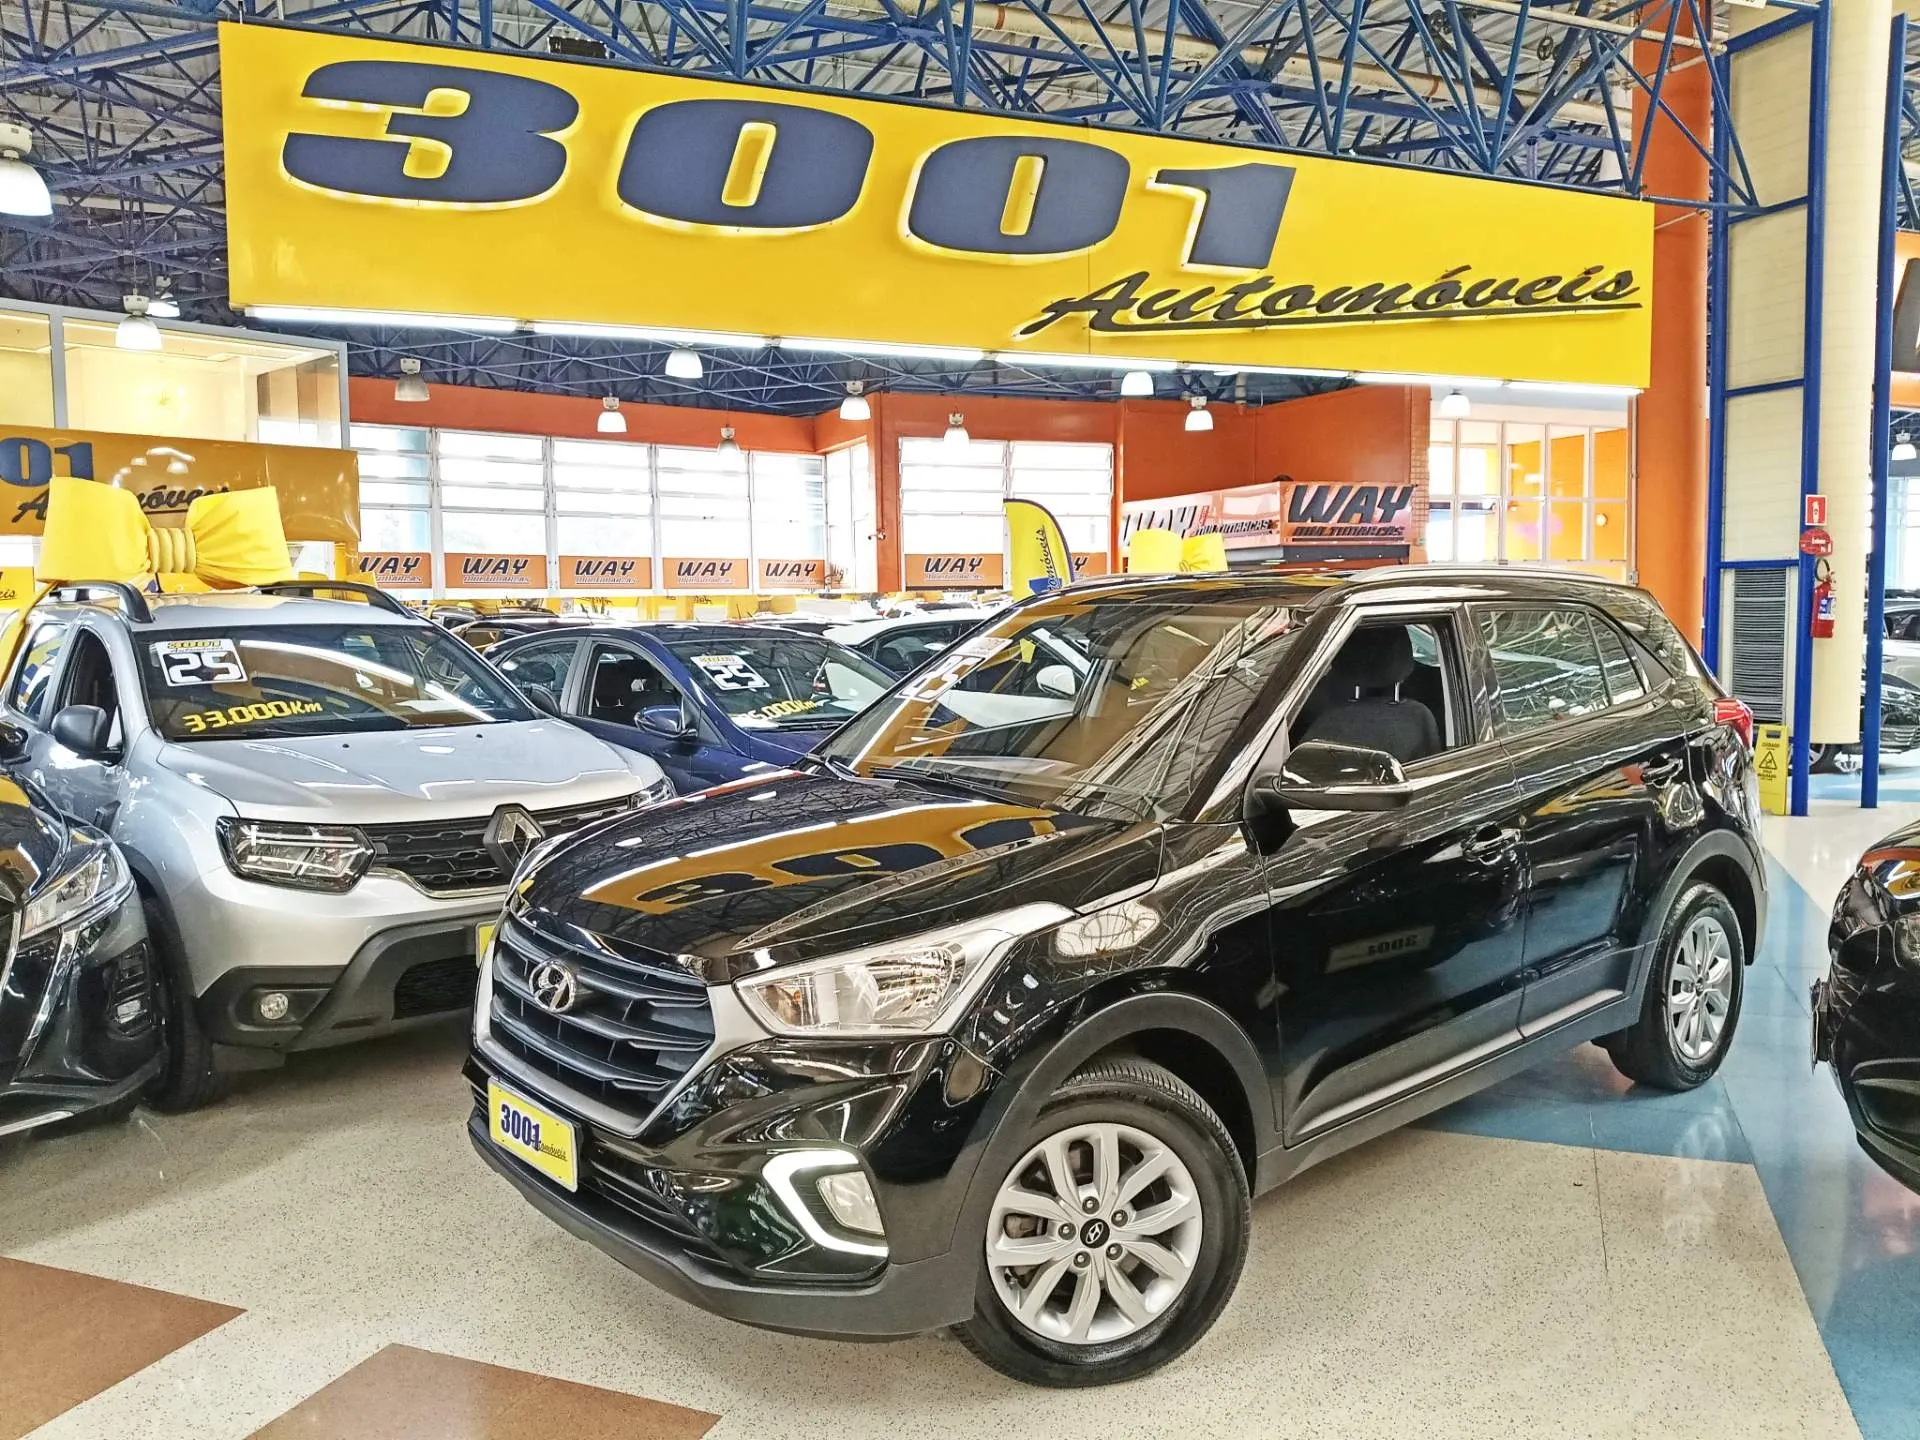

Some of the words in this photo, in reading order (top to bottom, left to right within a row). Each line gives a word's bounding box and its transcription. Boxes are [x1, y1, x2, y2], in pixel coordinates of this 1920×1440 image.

[282, 59, 1296, 270] 3001
[1018, 264, 1642, 337] Automóveis
[1287, 484, 1414, 524] WAY
[1293, 525, 1405, 537] MULTIMARCAS
[462, 557, 529, 575] WAY
[575, 559, 635, 576] WAY
[677, 561, 733, 577] WAY
[765, 562, 817, 577] WAY
[924, 557, 983, 573] WAY
[168, 652, 242, 684] 25
[705, 665, 765, 688] 25
[500, 1103, 540, 1151] 3001
